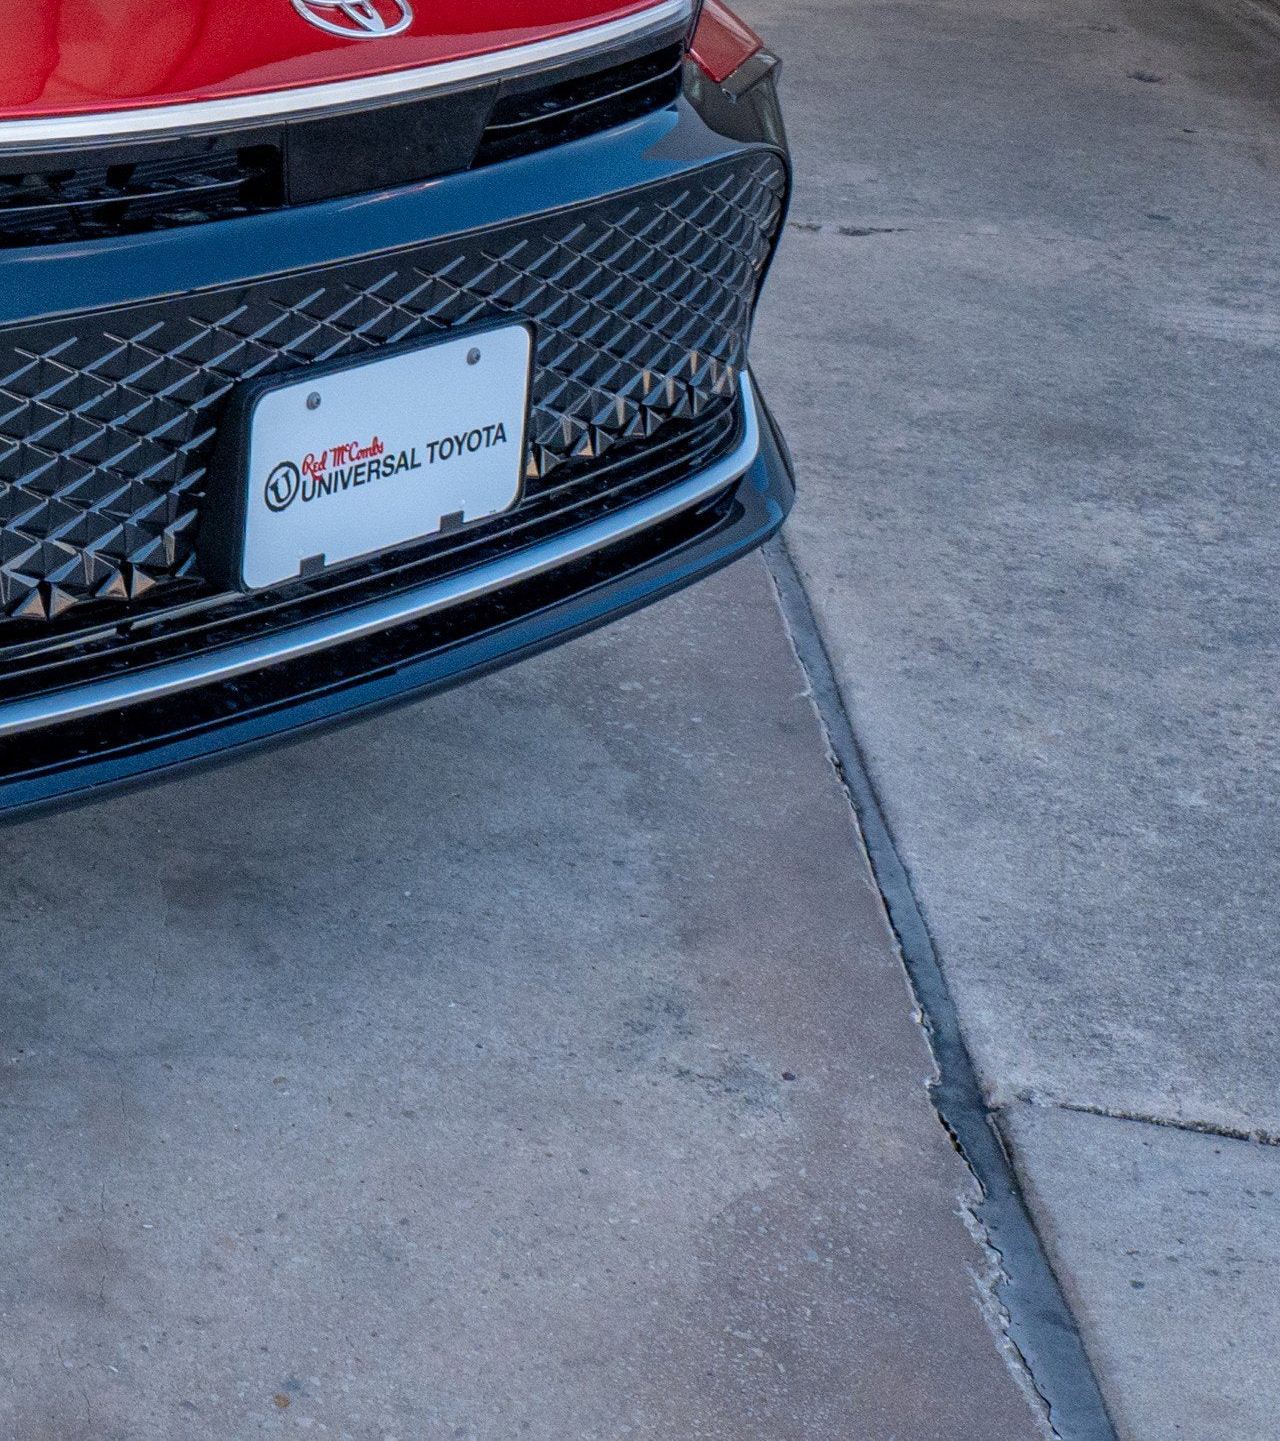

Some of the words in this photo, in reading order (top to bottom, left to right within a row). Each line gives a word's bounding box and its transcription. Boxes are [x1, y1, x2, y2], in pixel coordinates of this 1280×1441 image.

[301, 448, 328, 480] Red
[329, 436, 384, 467] McCombs
[301, 447, 423, 503] UNIVERSAL
[426, 422, 508, 465] TOYOTA
